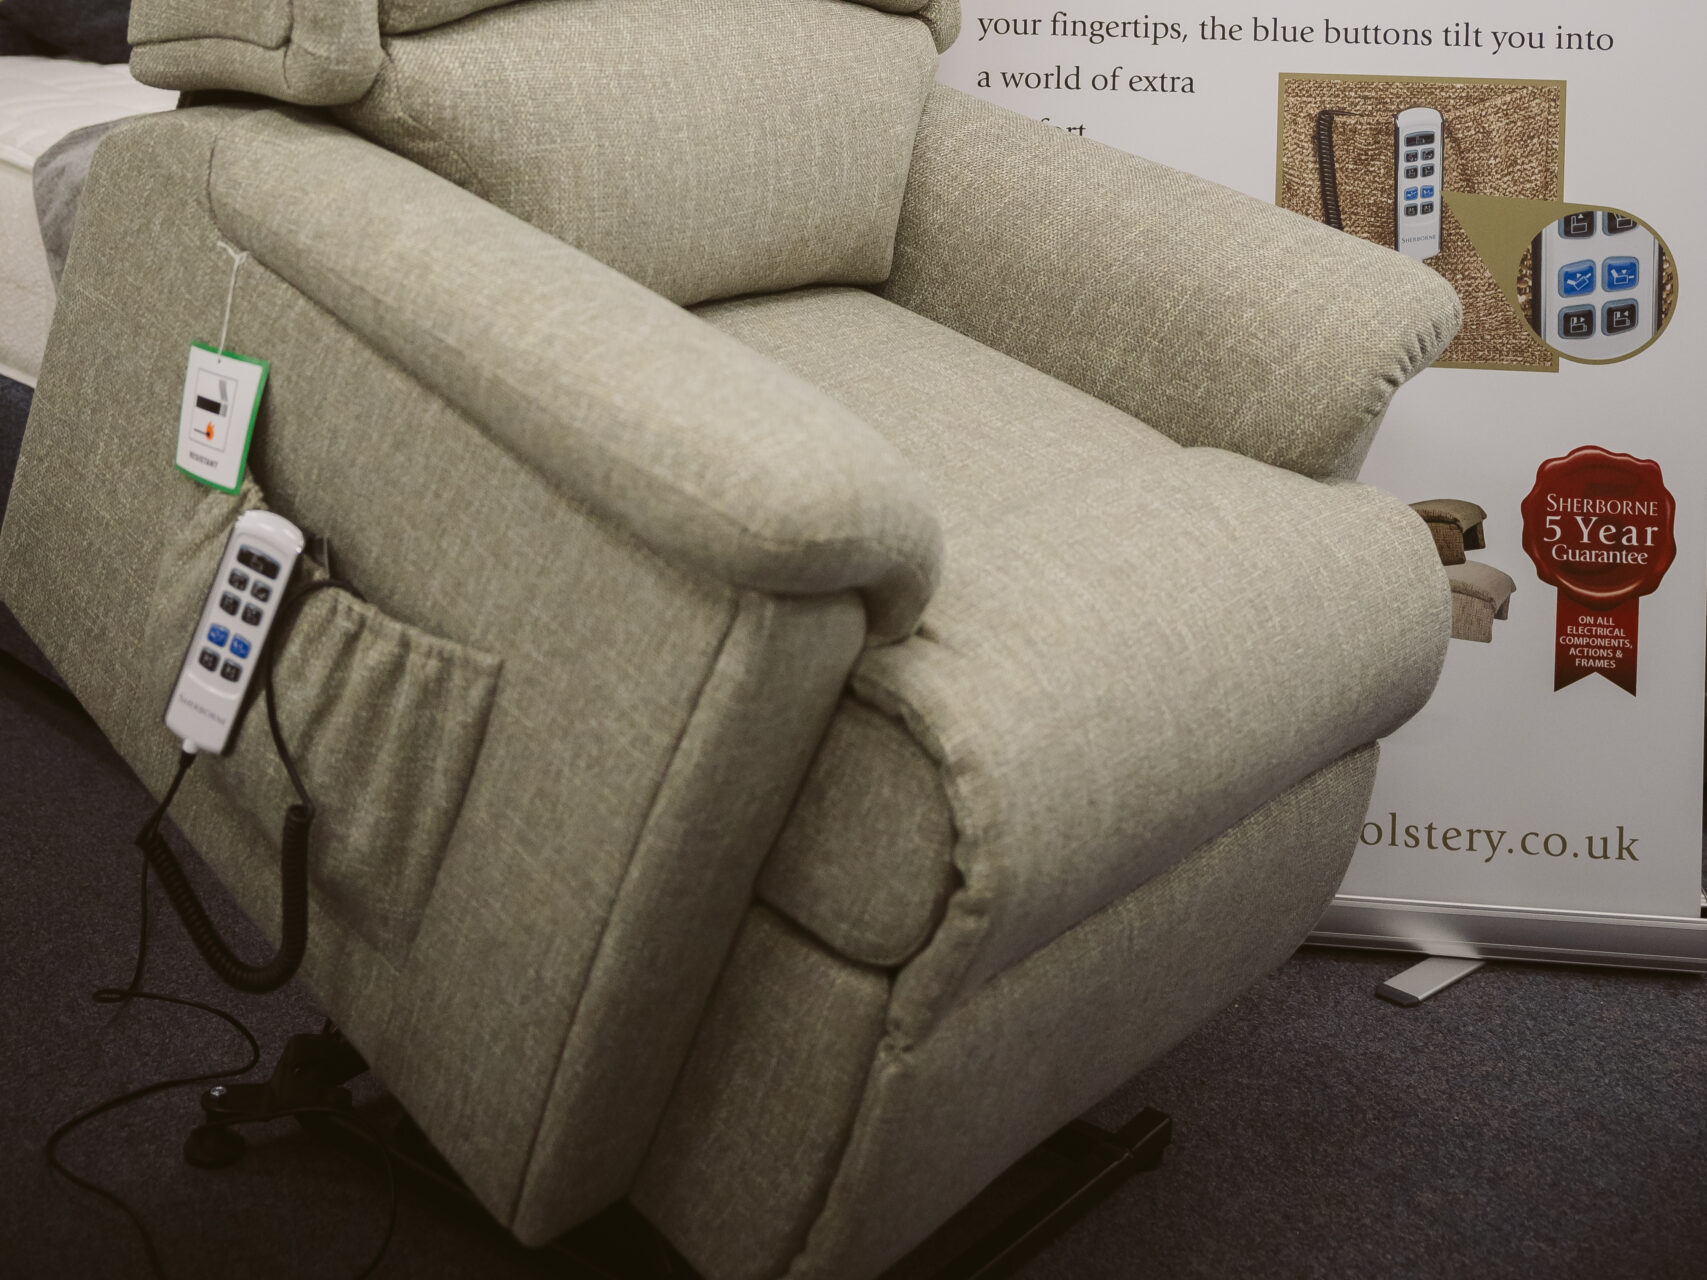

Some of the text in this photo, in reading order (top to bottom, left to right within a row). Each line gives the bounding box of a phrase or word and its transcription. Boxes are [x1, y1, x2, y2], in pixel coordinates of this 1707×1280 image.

[978, 12, 1613, 55] your fingertips, the blue buttons tilt you into
[978, 66, 1194, 93] a world of extra
[1546, 493, 1659, 517] SHERBORNE
[1543, 515, 1659, 546] 5 Year
[1552, 544, 1649, 565] Guarantee
[1579, 616, 1614, 625] ON ALL
[1566, 625, 1627, 637] ELECTRICAL
[1559, 635, 1633, 649] COMPONENTS,
[1569, 648, 1622, 658] ACTIONS &
[1576, 658, 1615, 668] FRAMES
